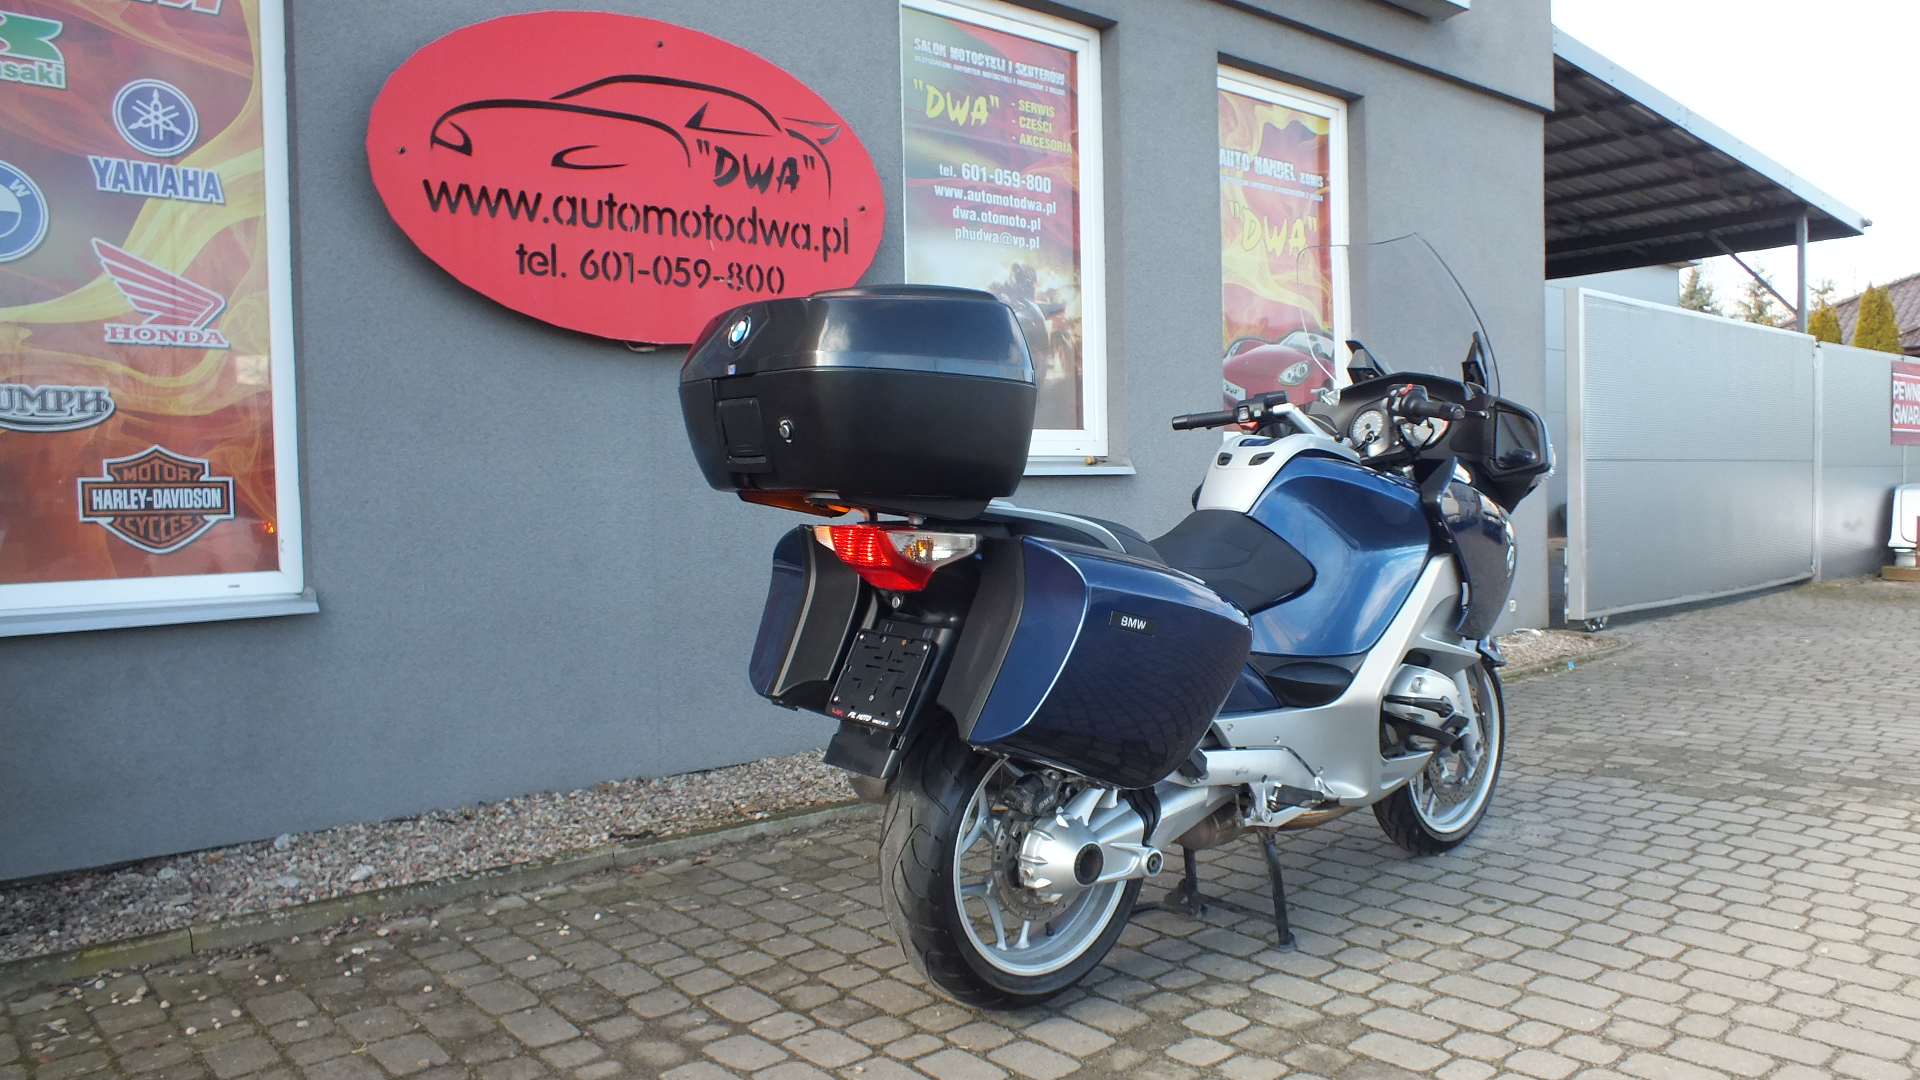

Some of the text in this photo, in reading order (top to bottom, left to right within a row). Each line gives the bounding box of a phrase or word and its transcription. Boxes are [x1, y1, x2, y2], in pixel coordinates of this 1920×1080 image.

[914, 38, 946, 57] SALON
[0, 63, 63, 85] saki
[1019, 100, 1055, 118] SERWIS
[1020, 133, 1072, 154] AKCESORIA
[89, 156, 224, 203] YAMAHA
[939, 162, 1052, 194] tel. 601-059-800
[934, 184, 1057, 214] www.automotodwa.pl
[422, 178, 849, 262] www.automotodwa.pl
[952, 205, 1041, 231] dwa.otomoto.pl
[955, 227, 1040, 250] phudwa@vp.pl
[516, 243, 785, 295] tel. 601-059-800
[106, 325, 227, 346] HONDA
[123, 461, 190, 482] MOTOR
[92, 487, 222, 511] HARLEY-DAVIDSON
[123, 515, 194, 540] CYCLES
[1120, 615, 1147, 630] BMW
